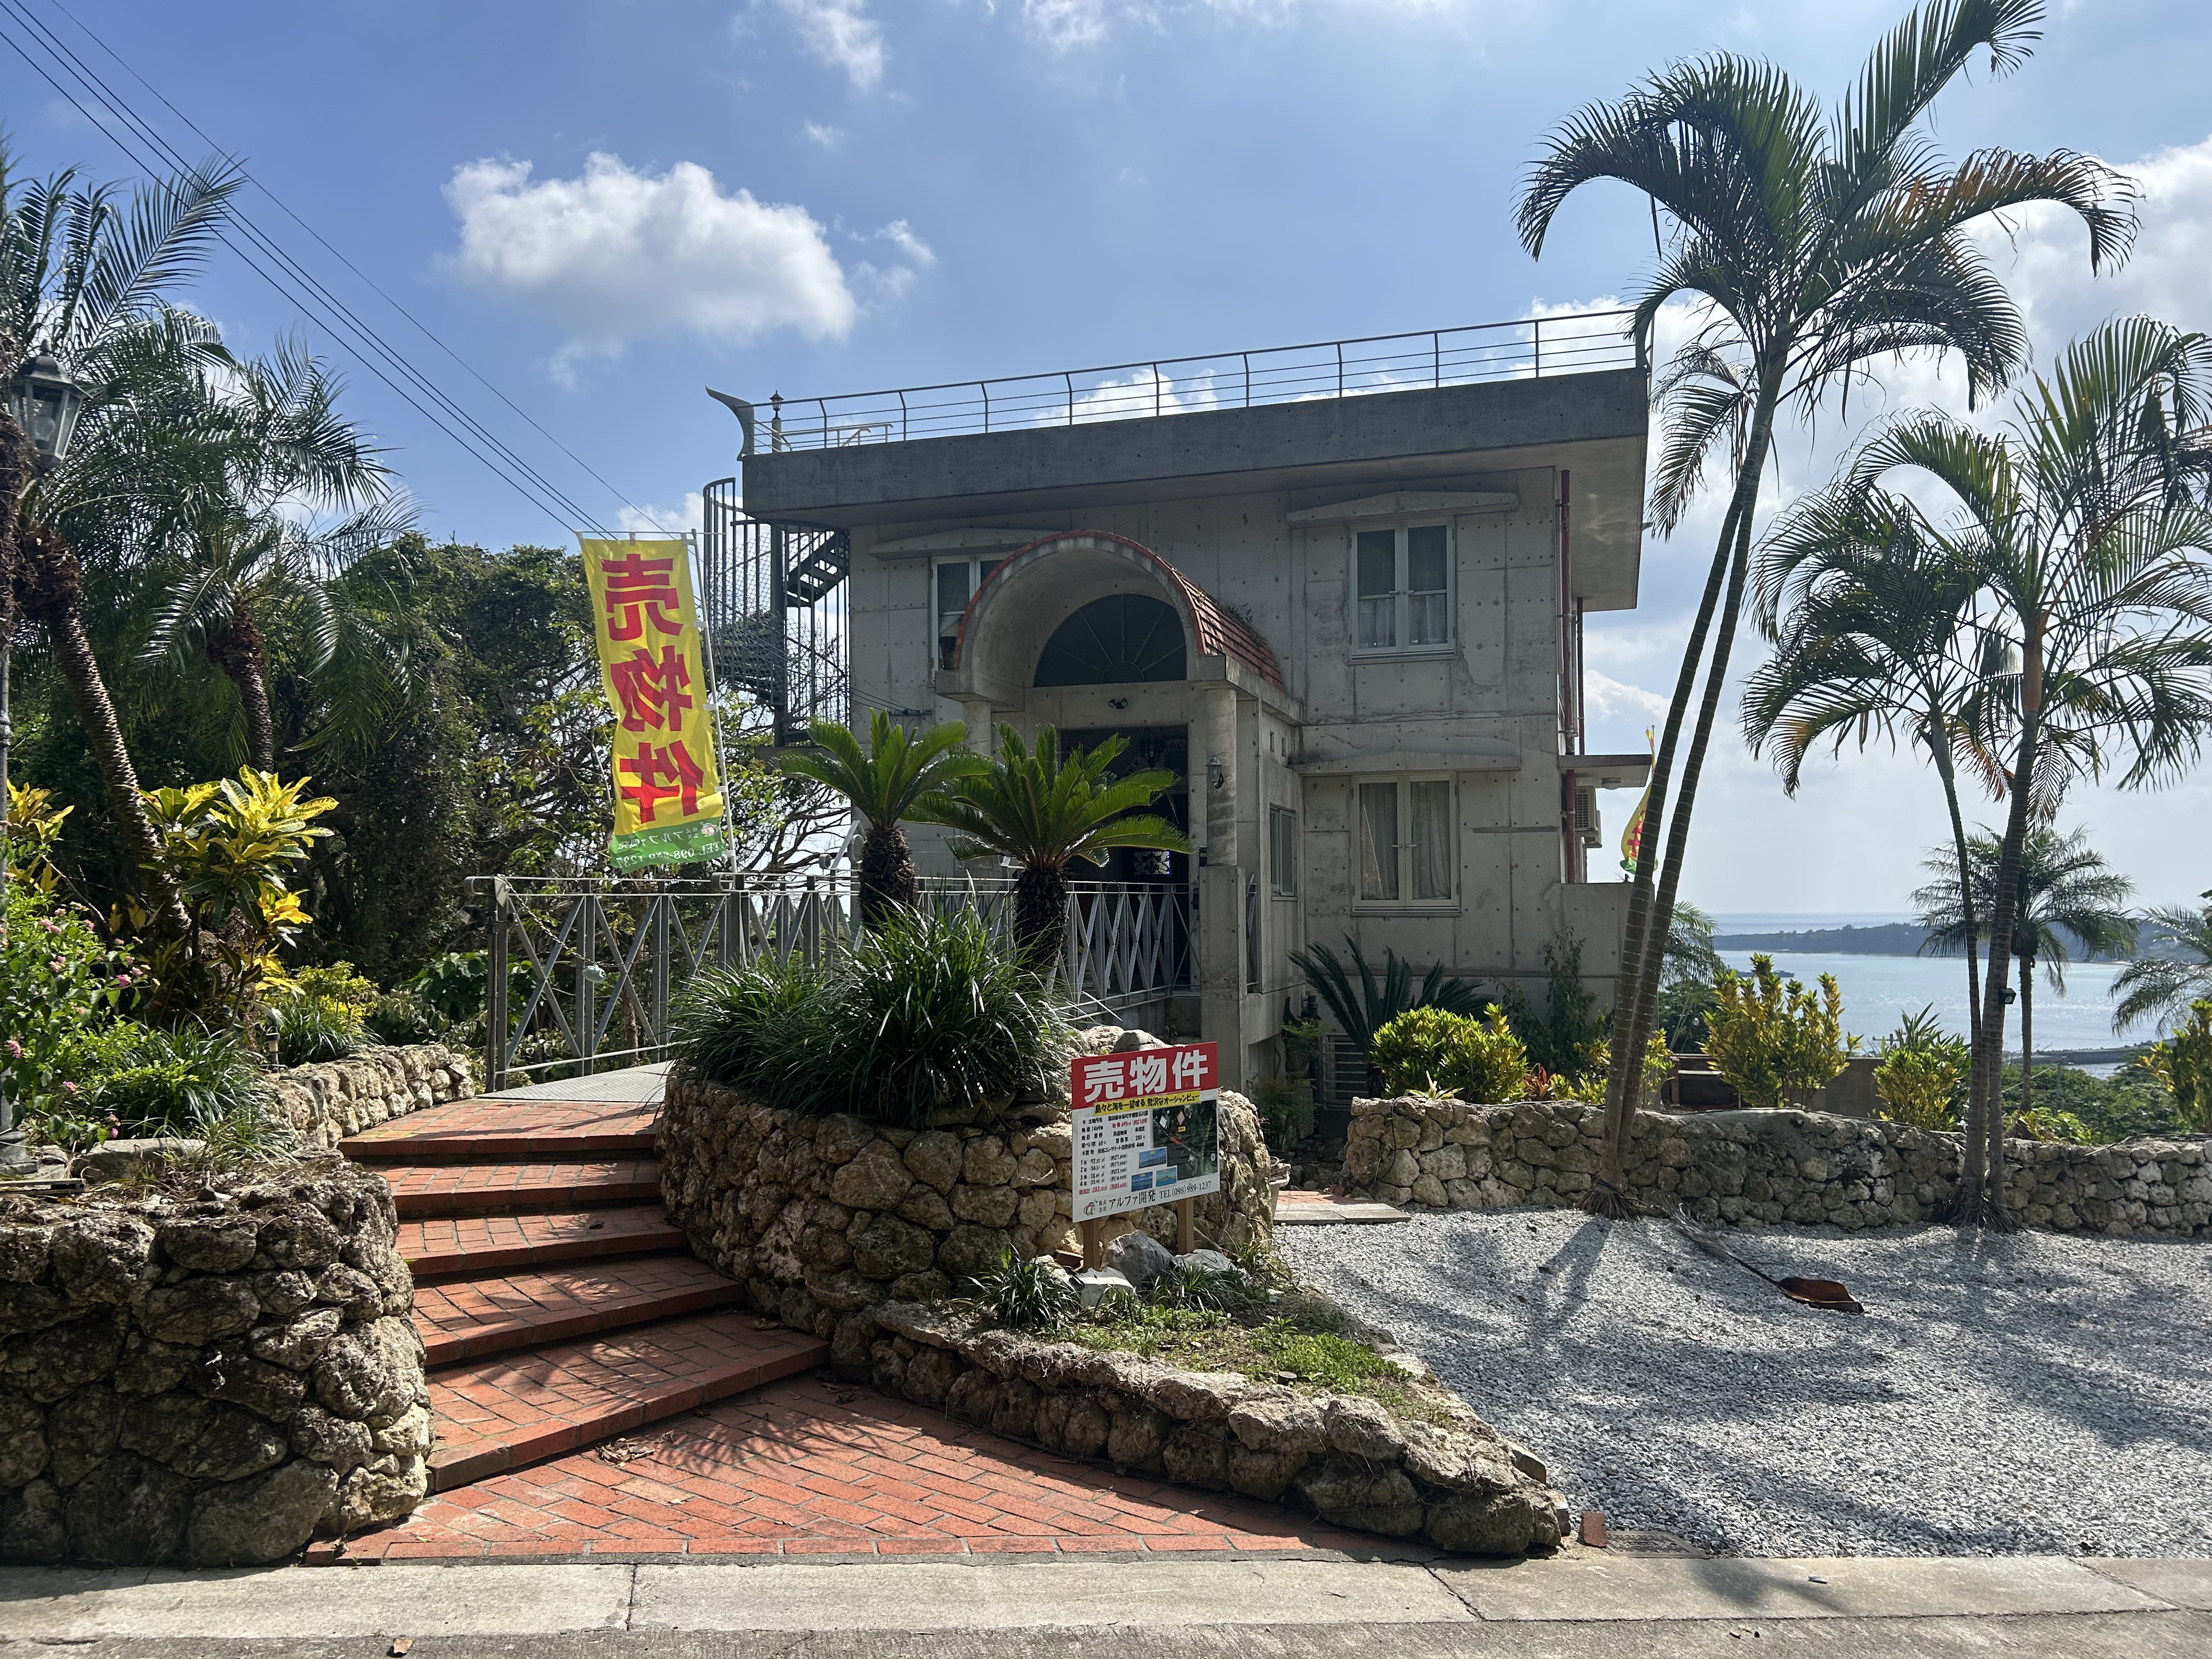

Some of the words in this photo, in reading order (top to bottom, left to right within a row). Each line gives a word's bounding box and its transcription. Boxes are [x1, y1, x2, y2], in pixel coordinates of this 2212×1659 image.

[1084, 1049, 1208, 1103] 売物件
[1109, 1189, 1156, 1210] アルファ開発
[1159, 1189, 1171, 1199] TEL
